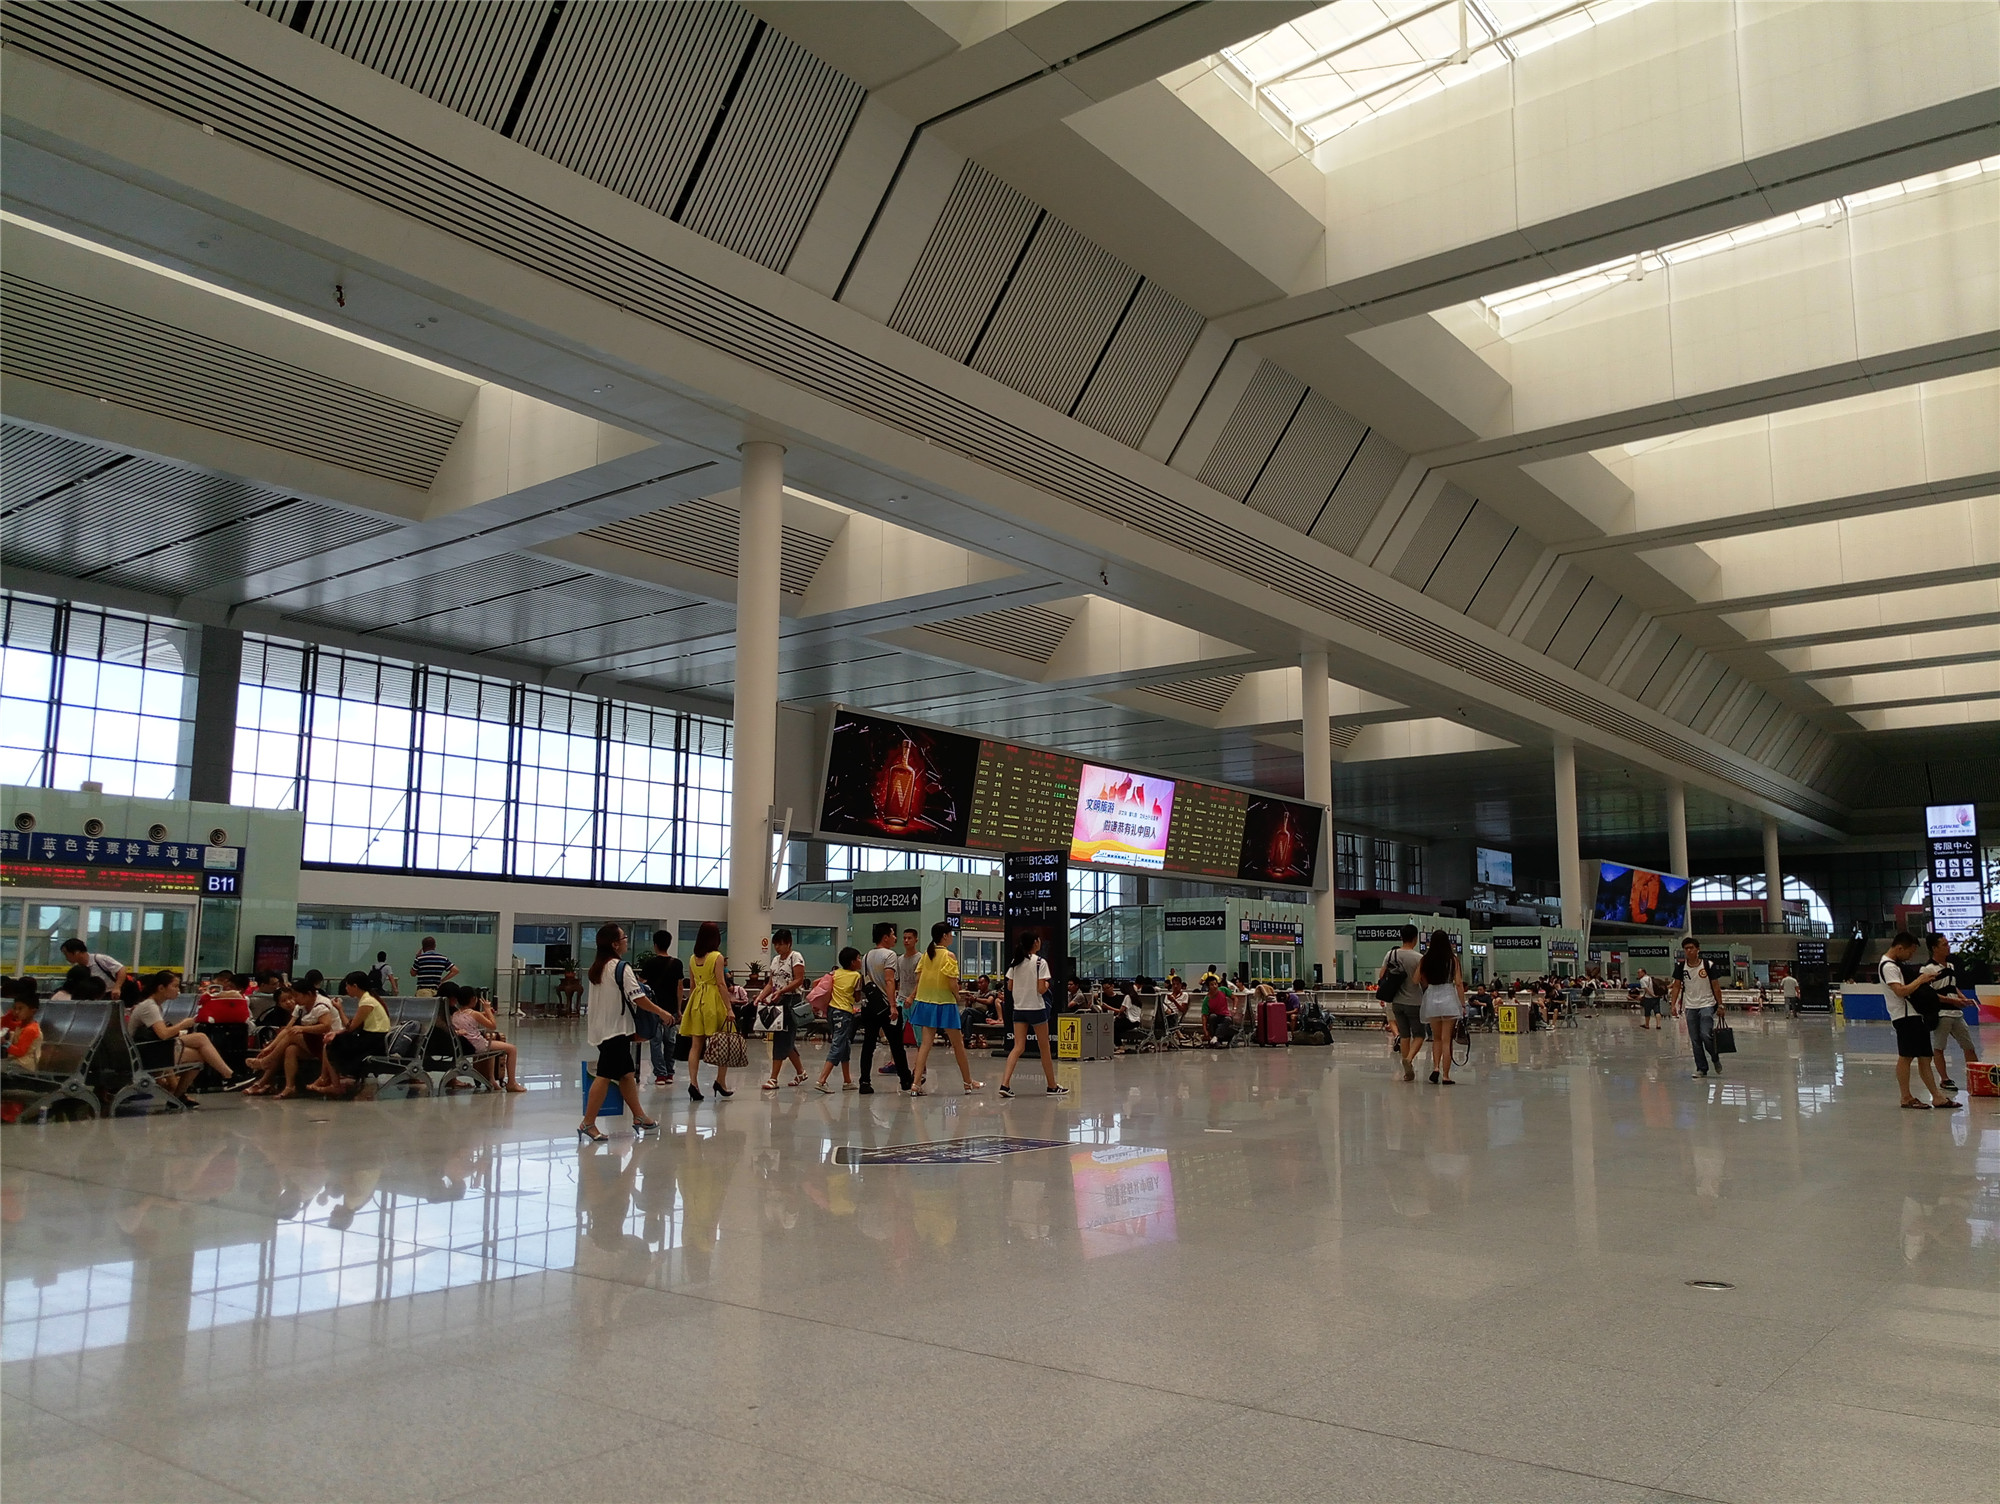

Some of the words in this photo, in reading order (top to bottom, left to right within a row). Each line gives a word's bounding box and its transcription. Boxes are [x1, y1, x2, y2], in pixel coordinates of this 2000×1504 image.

[41, 837, 199, 860] 蓝色车票检票通道
[1933, 841, 1973, 850] 客服中心
[1028, 855, 1059, 866] B12-B24
[1028, 871, 1058, 882] B10-B11
[208, 876, 235, 892] B11
[872, 894, 910, 907] B12-B24
[947, 916, 959, 927] B12
[1181, 916, 1216, 926] B14-B24
[557, 927, 566, 941] 2
[1370, 929, 1401, 938] B16-B24
